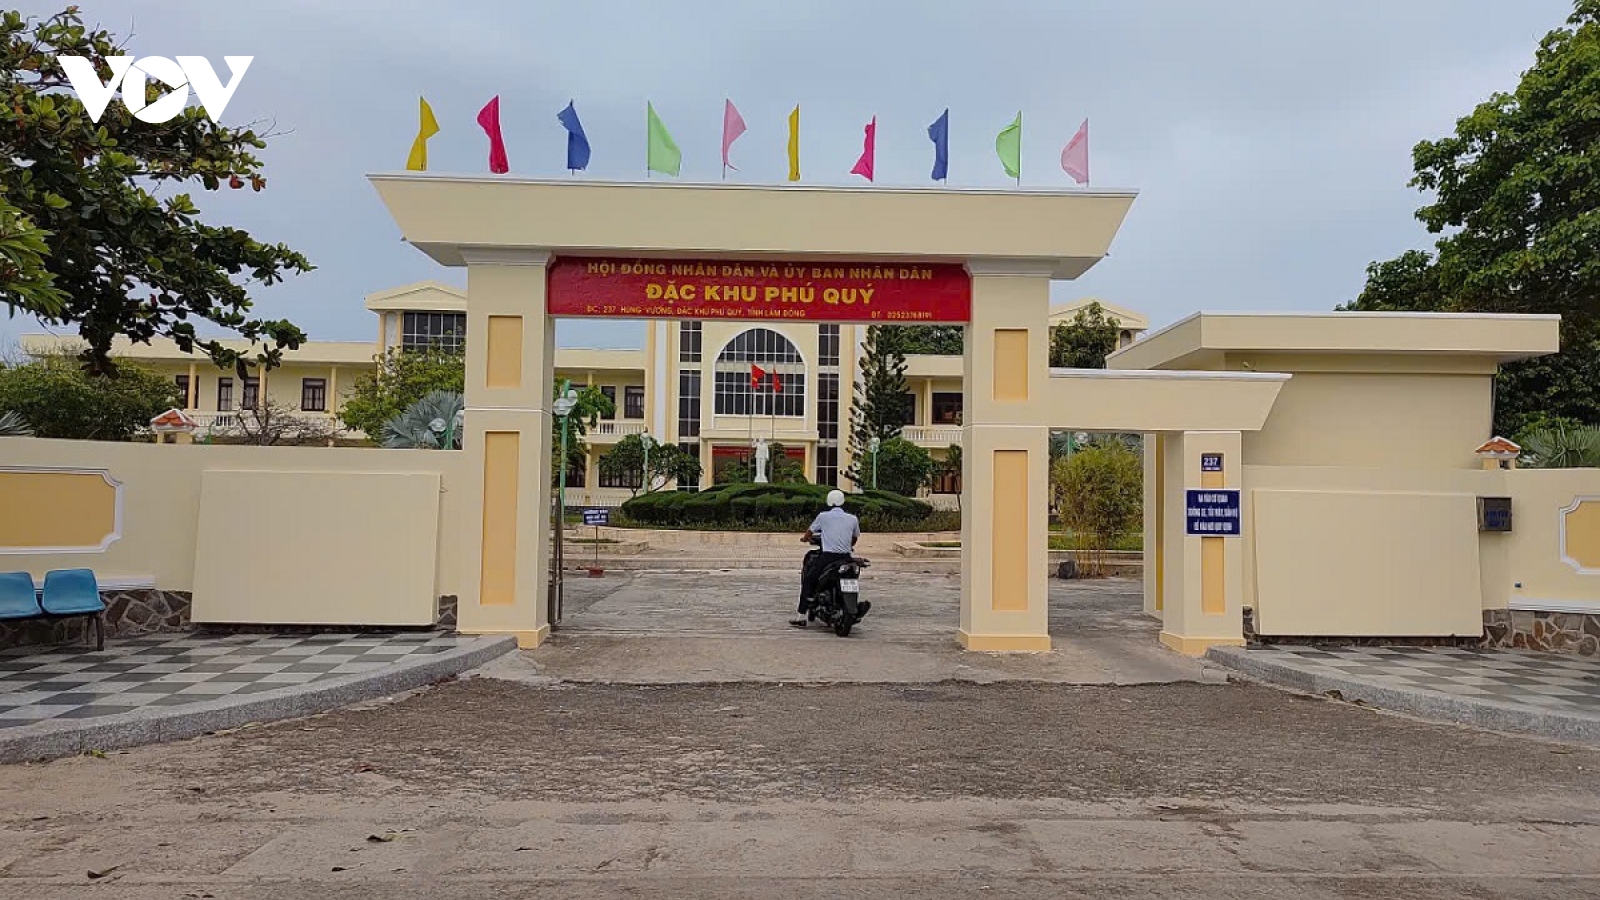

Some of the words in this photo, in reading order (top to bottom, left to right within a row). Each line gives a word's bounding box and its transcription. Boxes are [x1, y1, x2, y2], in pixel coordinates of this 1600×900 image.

[587, 261, 615, 277] HỘI
[620, 259, 666, 275] ĐỒNG
[671, 262, 717, 277] NHÂN
[722, 263, 754, 277] DÂN
[760, 264, 779, 278] VÀ
[784, 263, 805, 279] ỦY
[811, 267, 845, 279] BAN
[849, 265, 894, 279] NHÂN
[899, 266, 933, 280] DÂN
[645, 280, 696, 304] ĐẶC
[704, 285, 757, 302] KHU
[764, 282, 815, 303] PHÚ
[823, 283, 875, 305] QUÝ
[603, 305, 616, 314] 237
[694, 306, 710, 316] KHU
[1203, 457, 1218, 466] 237
